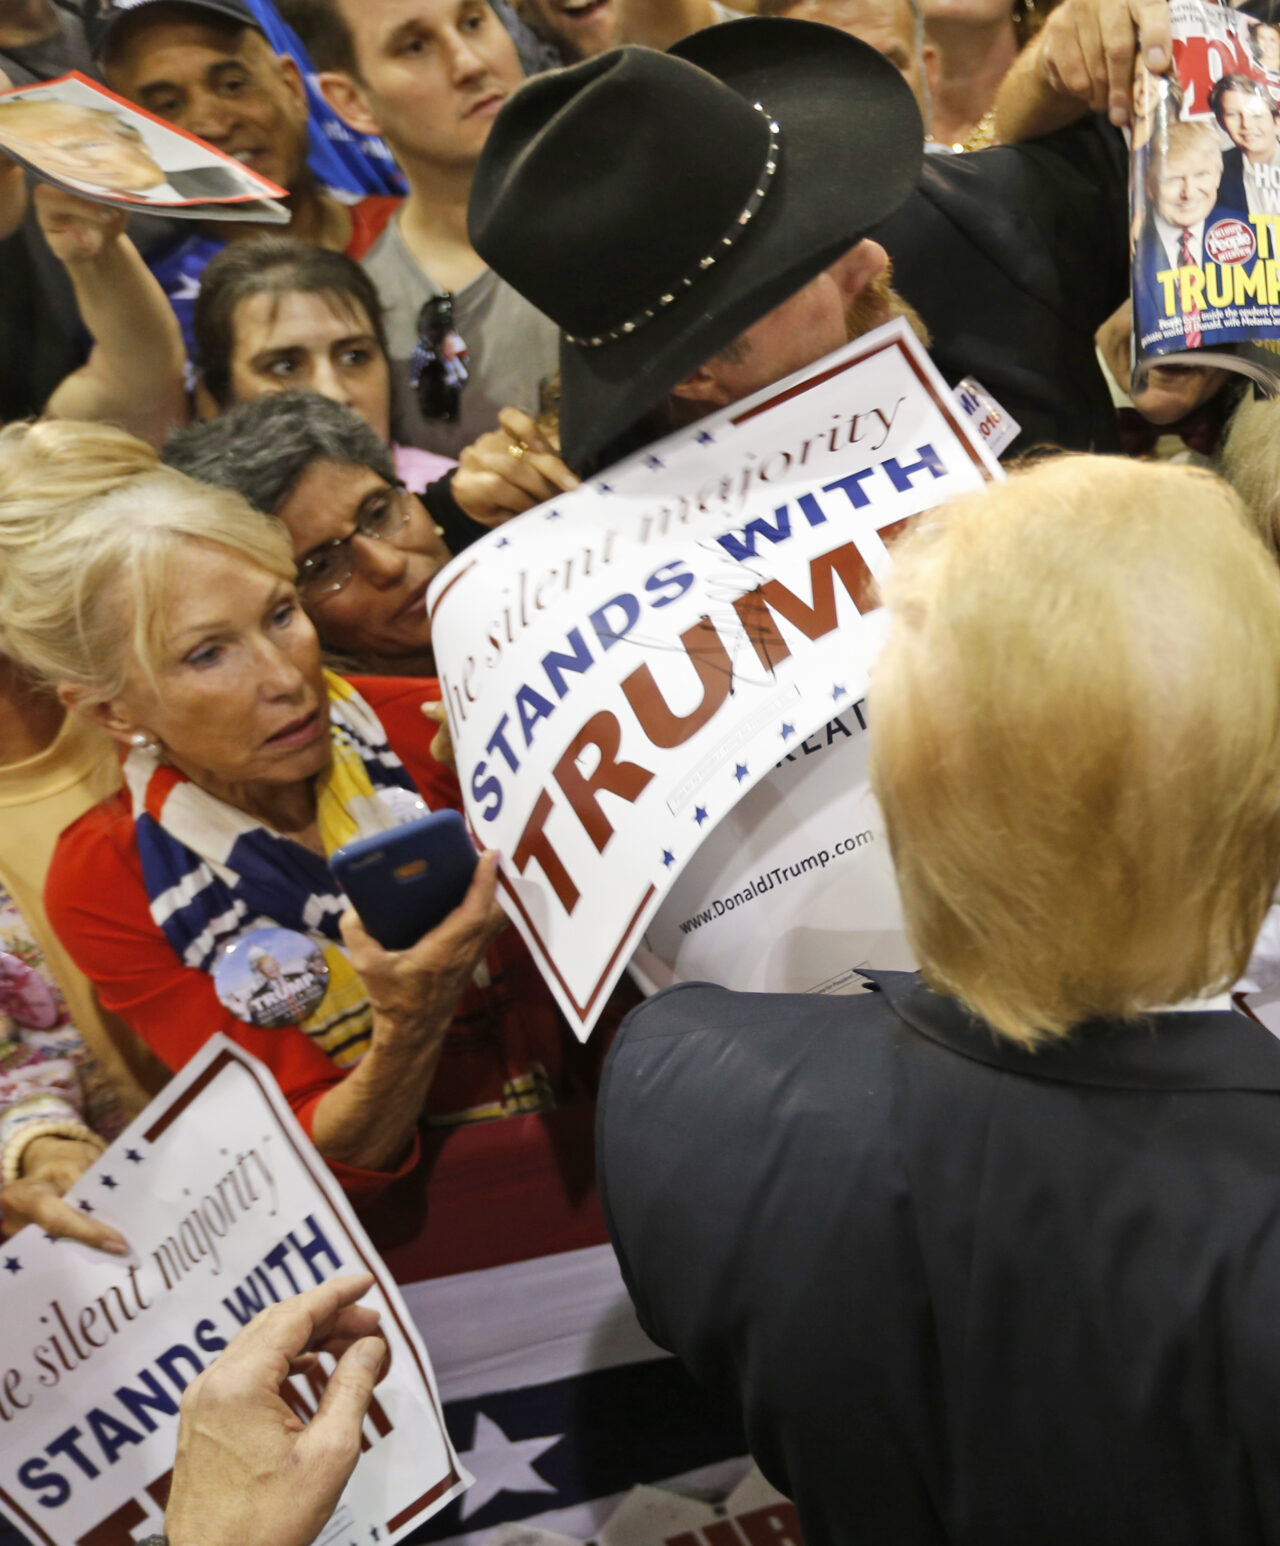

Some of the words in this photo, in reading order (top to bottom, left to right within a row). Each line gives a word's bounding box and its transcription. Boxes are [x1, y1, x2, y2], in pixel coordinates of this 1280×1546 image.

[443, 656, 482, 739] he
[486, 531, 616, 668] silent
[638, 396, 907, 545] majority
[980, 410, 1001, 440] 016
[471, 560, 695, 822] STANDS
[716, 444, 949, 562] WITH
[511, 505, 935, 916] TRUM
[679, 829, 874, 935] www.DonaldJTrump.com
[18, 1319, 227, 1508] STANDS
[222, 1214, 342, 1326] WITH
[33, 1264, 152, 1386] silent
[153, 1135, 279, 1290] majority
